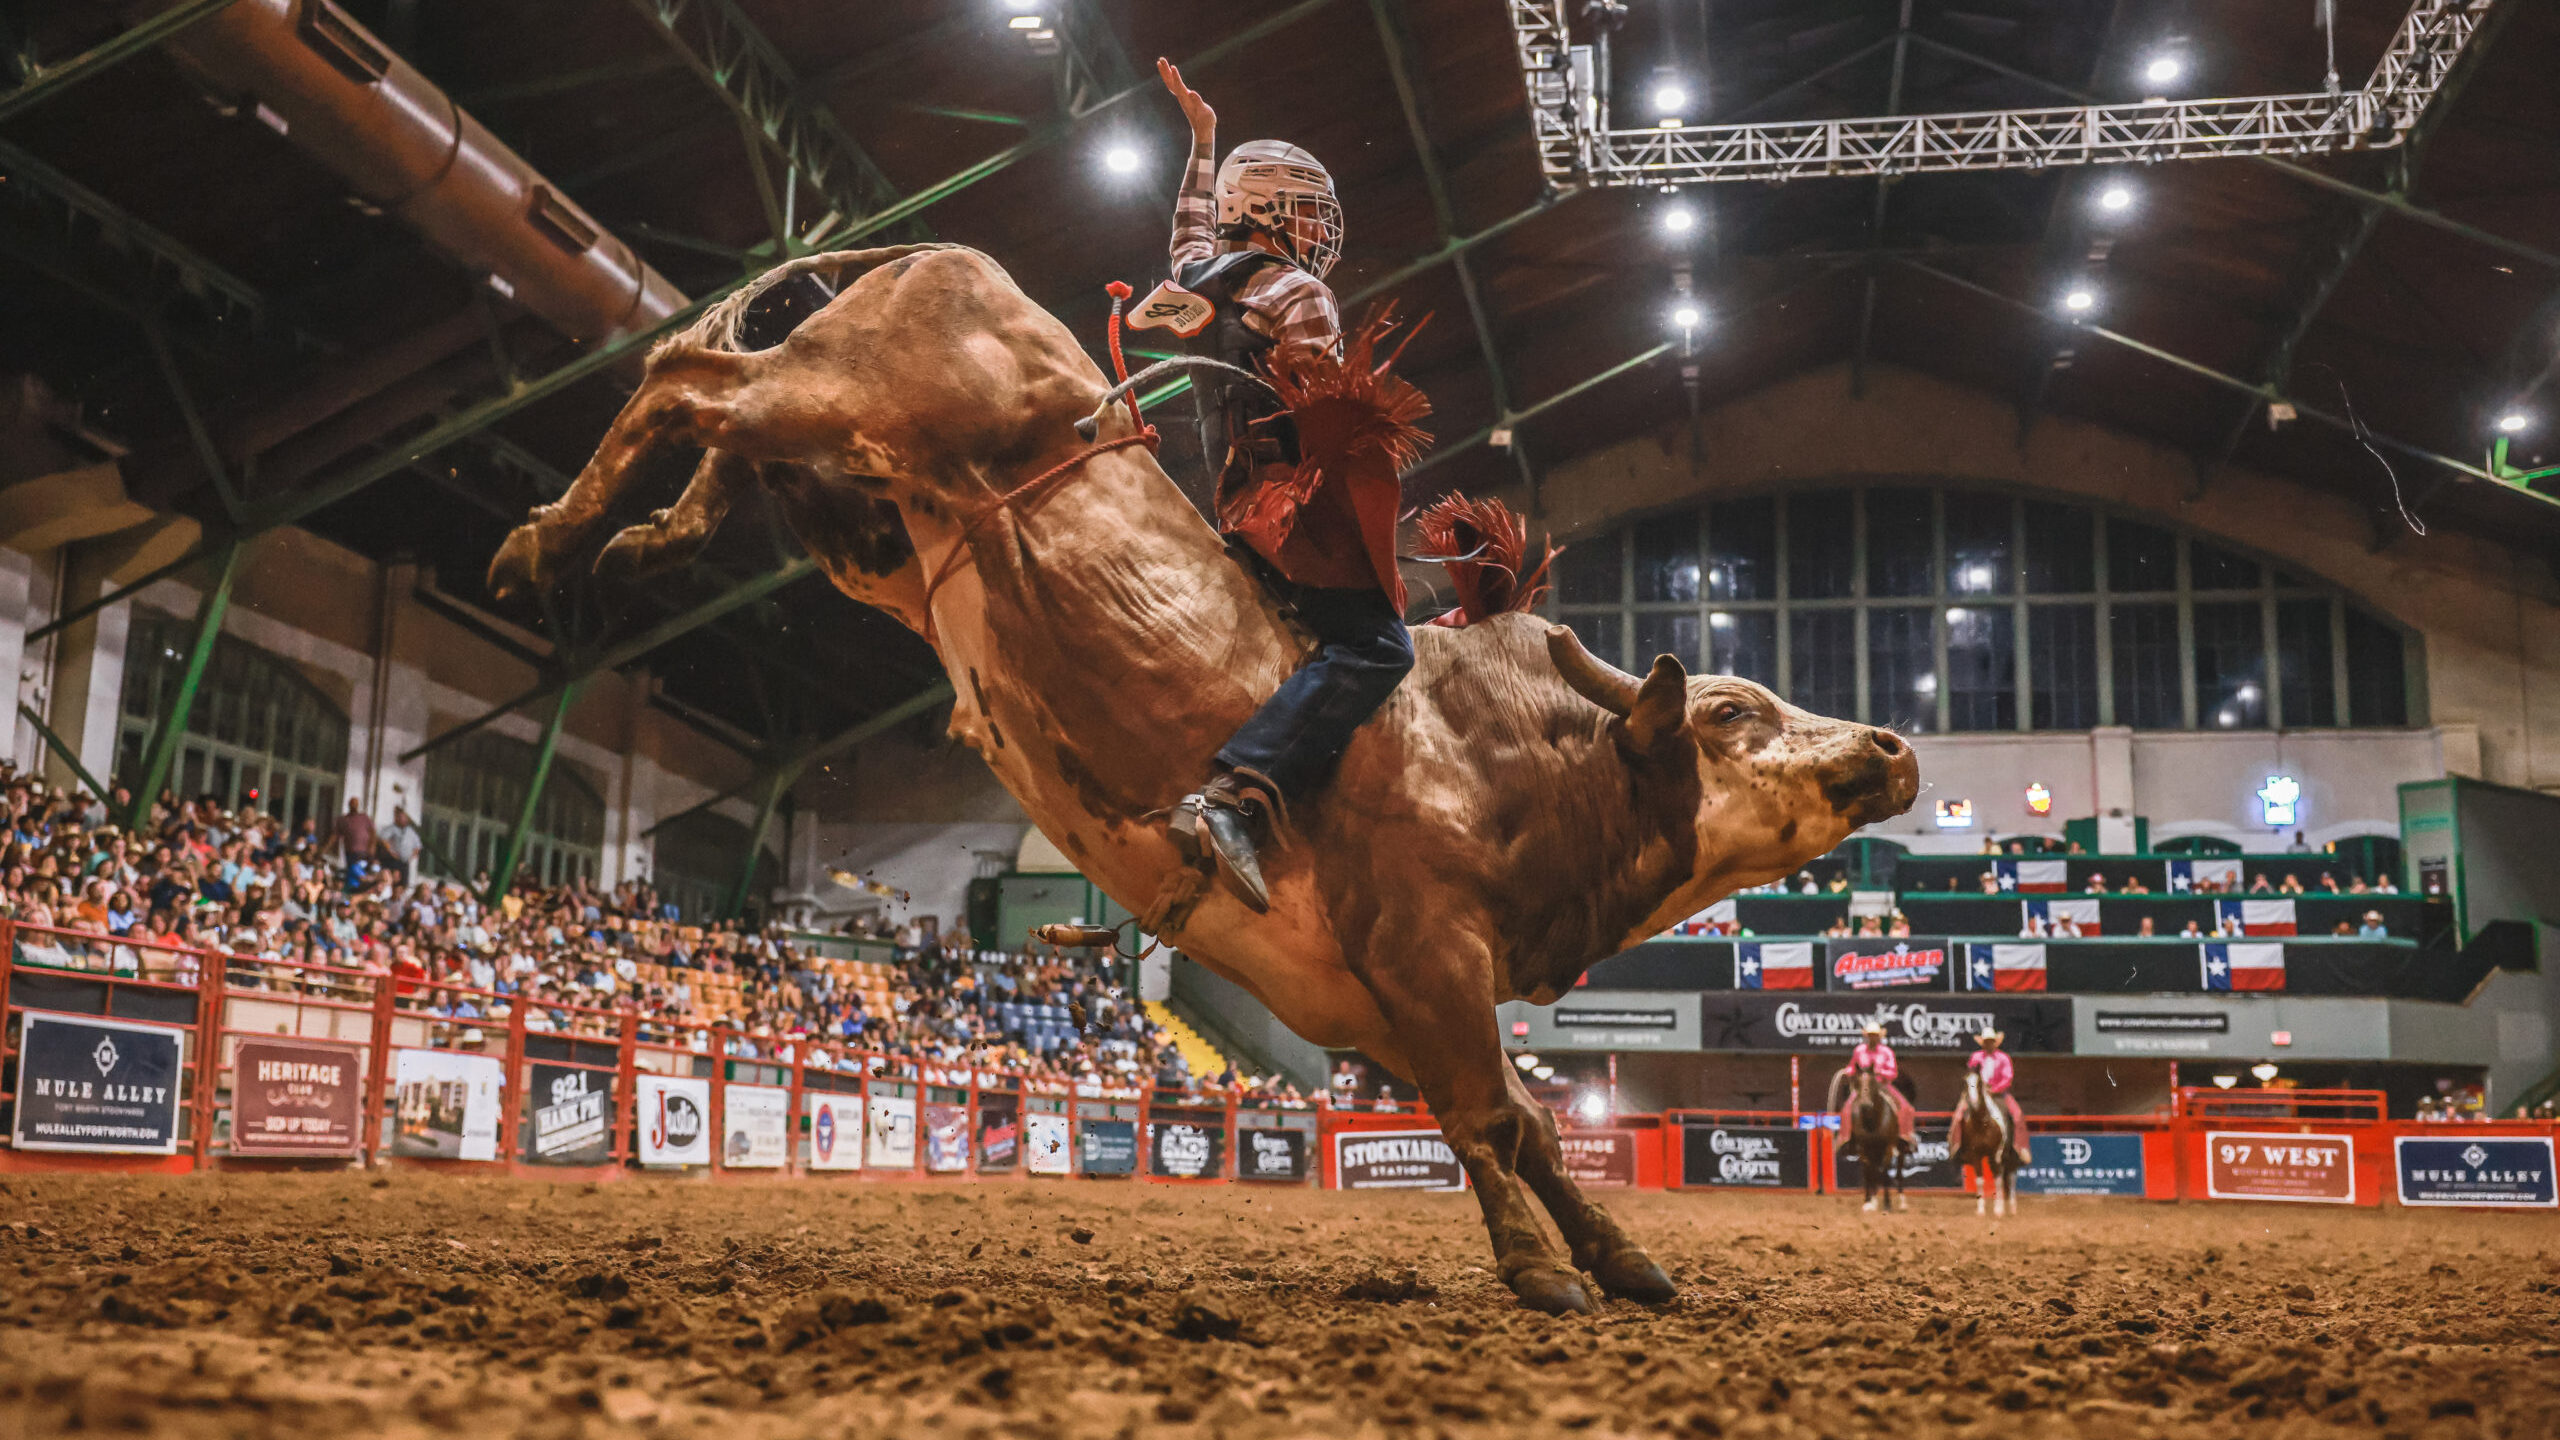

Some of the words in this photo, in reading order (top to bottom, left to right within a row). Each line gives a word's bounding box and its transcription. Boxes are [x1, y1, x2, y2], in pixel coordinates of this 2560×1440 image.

[1834, 949, 1944, 978] American
[258, 1060, 342, 1087] HERITAGE
[35, 1078, 93, 1100] MULE
[103, 1083, 167, 1105] ALLEY
[1344, 1139, 1456, 1168] STOCKYARDS
[2220, 1144, 2252, 1165] 97
[2262, 1145, 2340, 1168] WEST
[1370, 1165, 1430, 1177] STATION
[2412, 1169, 2467, 1182] MULE
[2477, 1170, 2542, 1183] ALLEY
